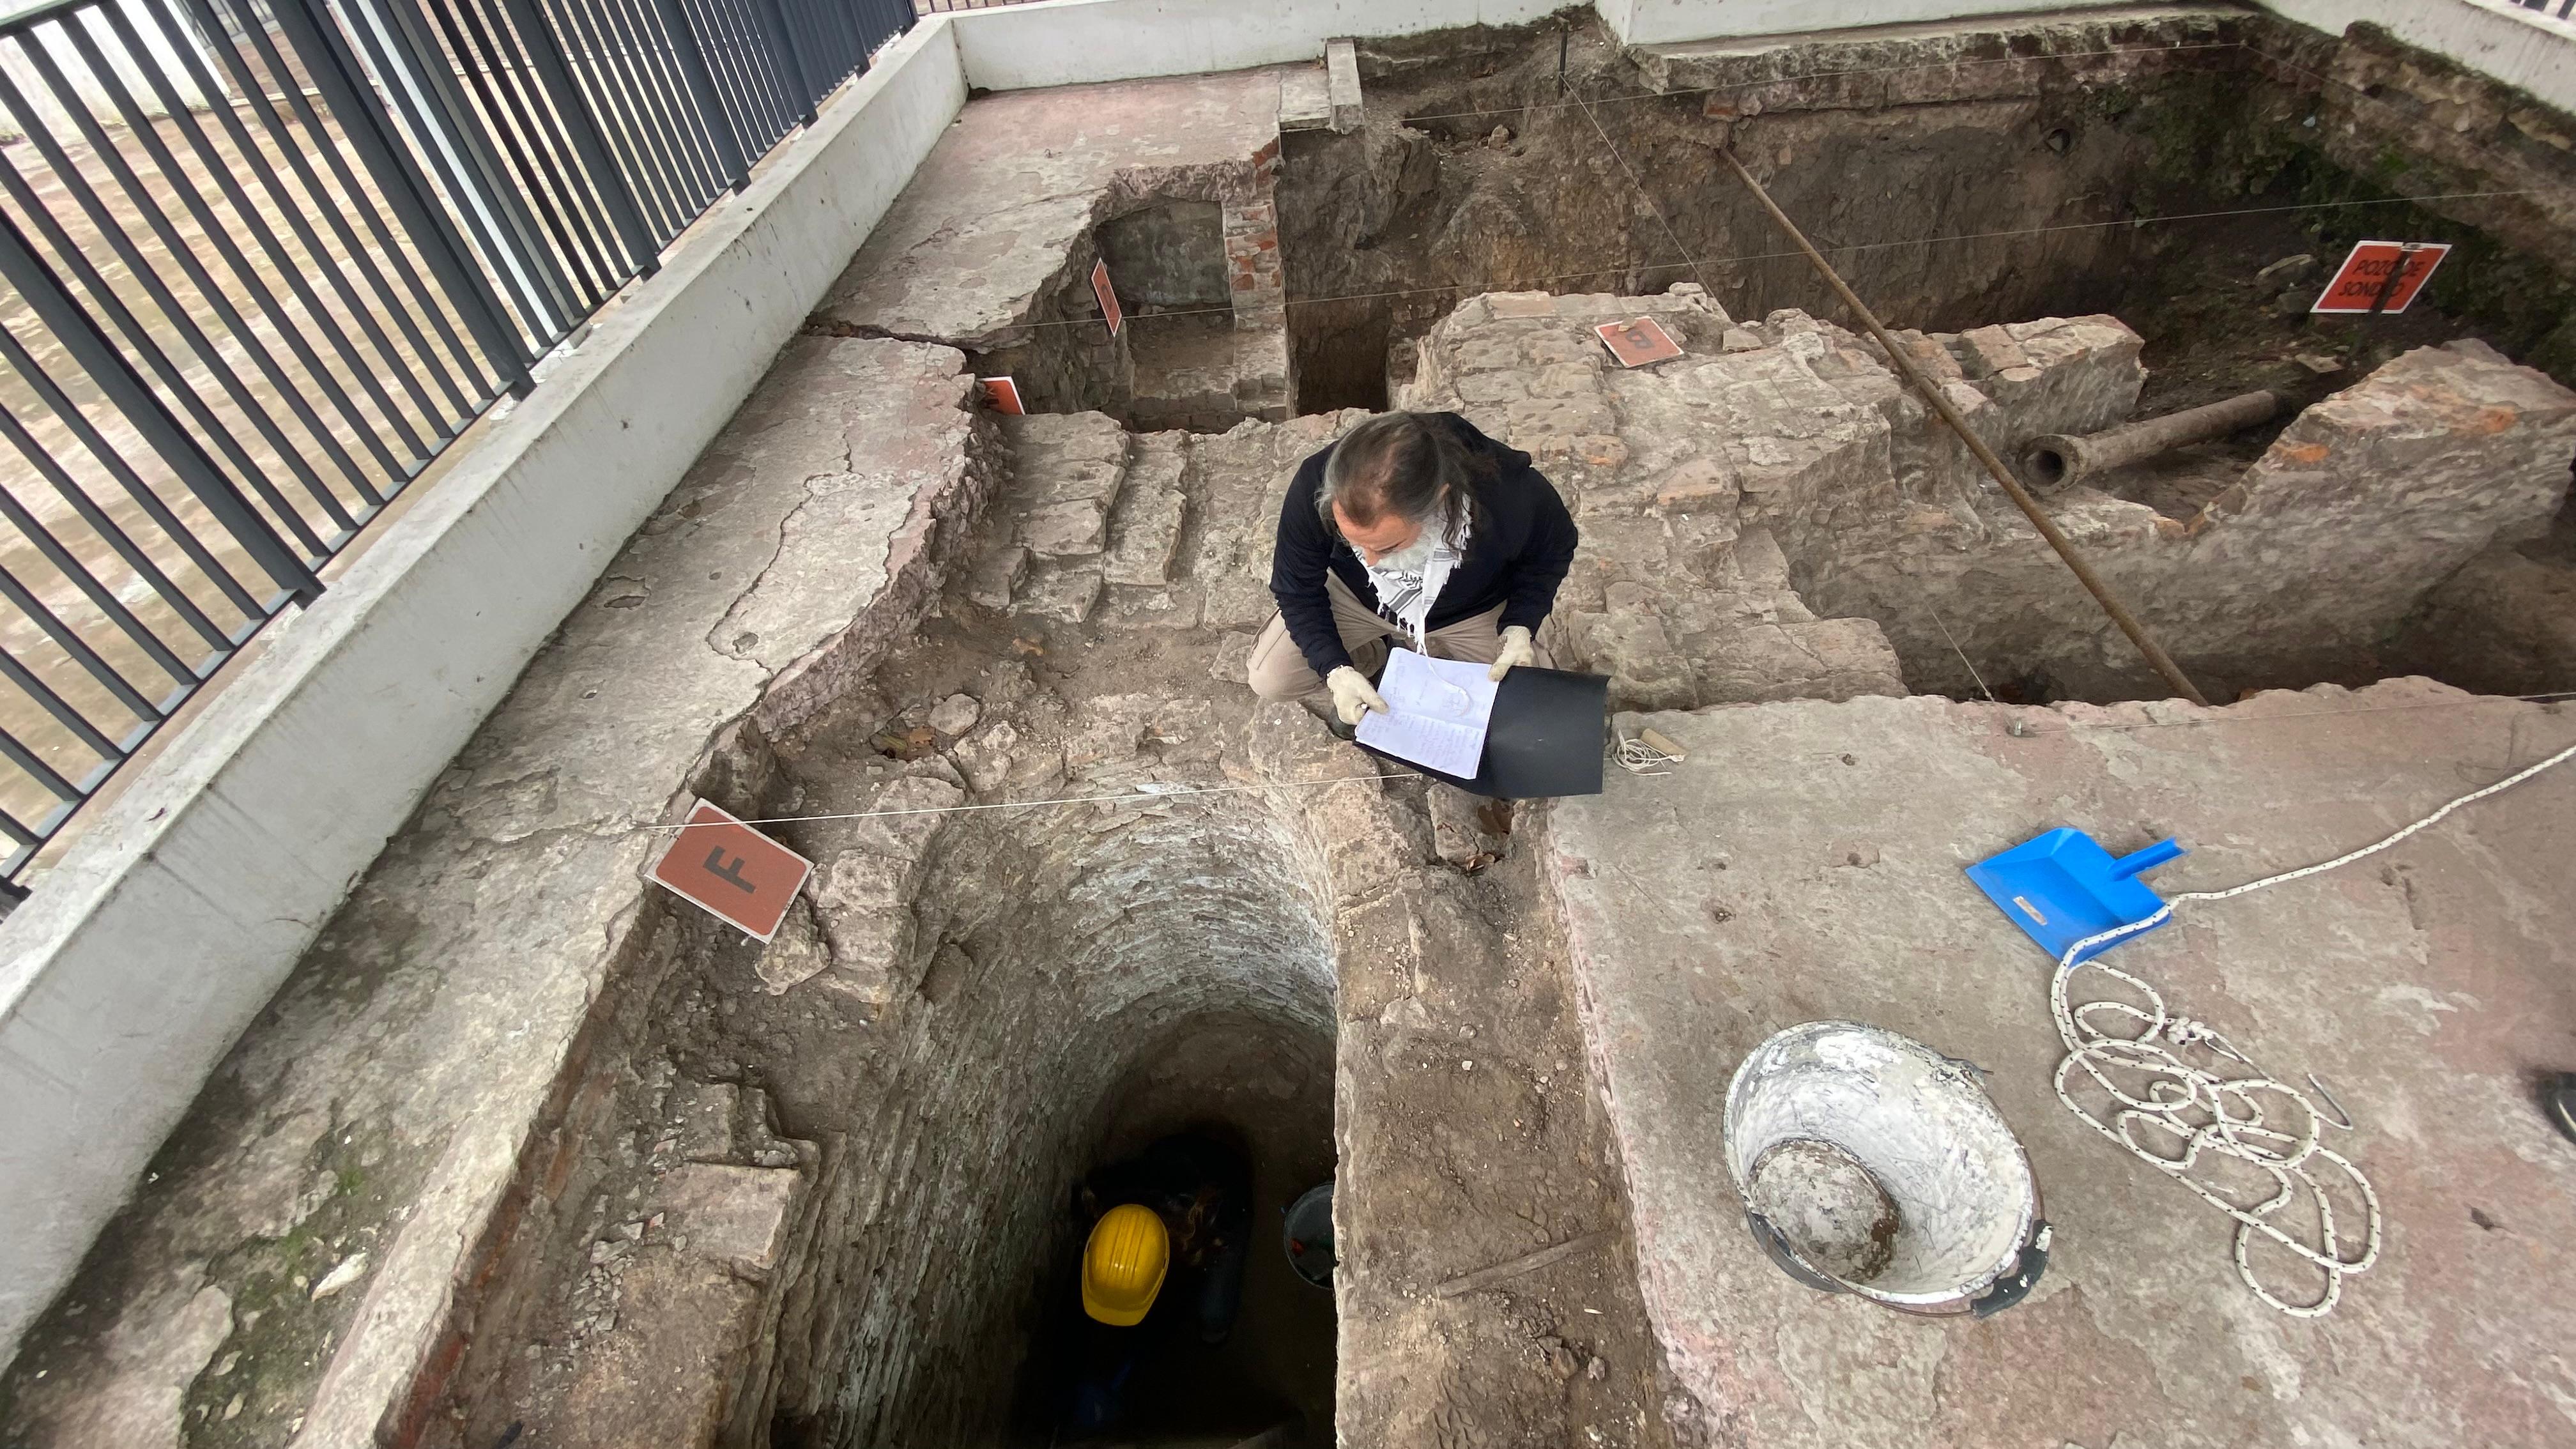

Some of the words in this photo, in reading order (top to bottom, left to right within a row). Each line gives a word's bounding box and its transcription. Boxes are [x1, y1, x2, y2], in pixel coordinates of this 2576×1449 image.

[2352, 259, 2395, 276] POZO
[2338, 281, 2404, 296] SONDO
[703, 845, 757, 894] F
